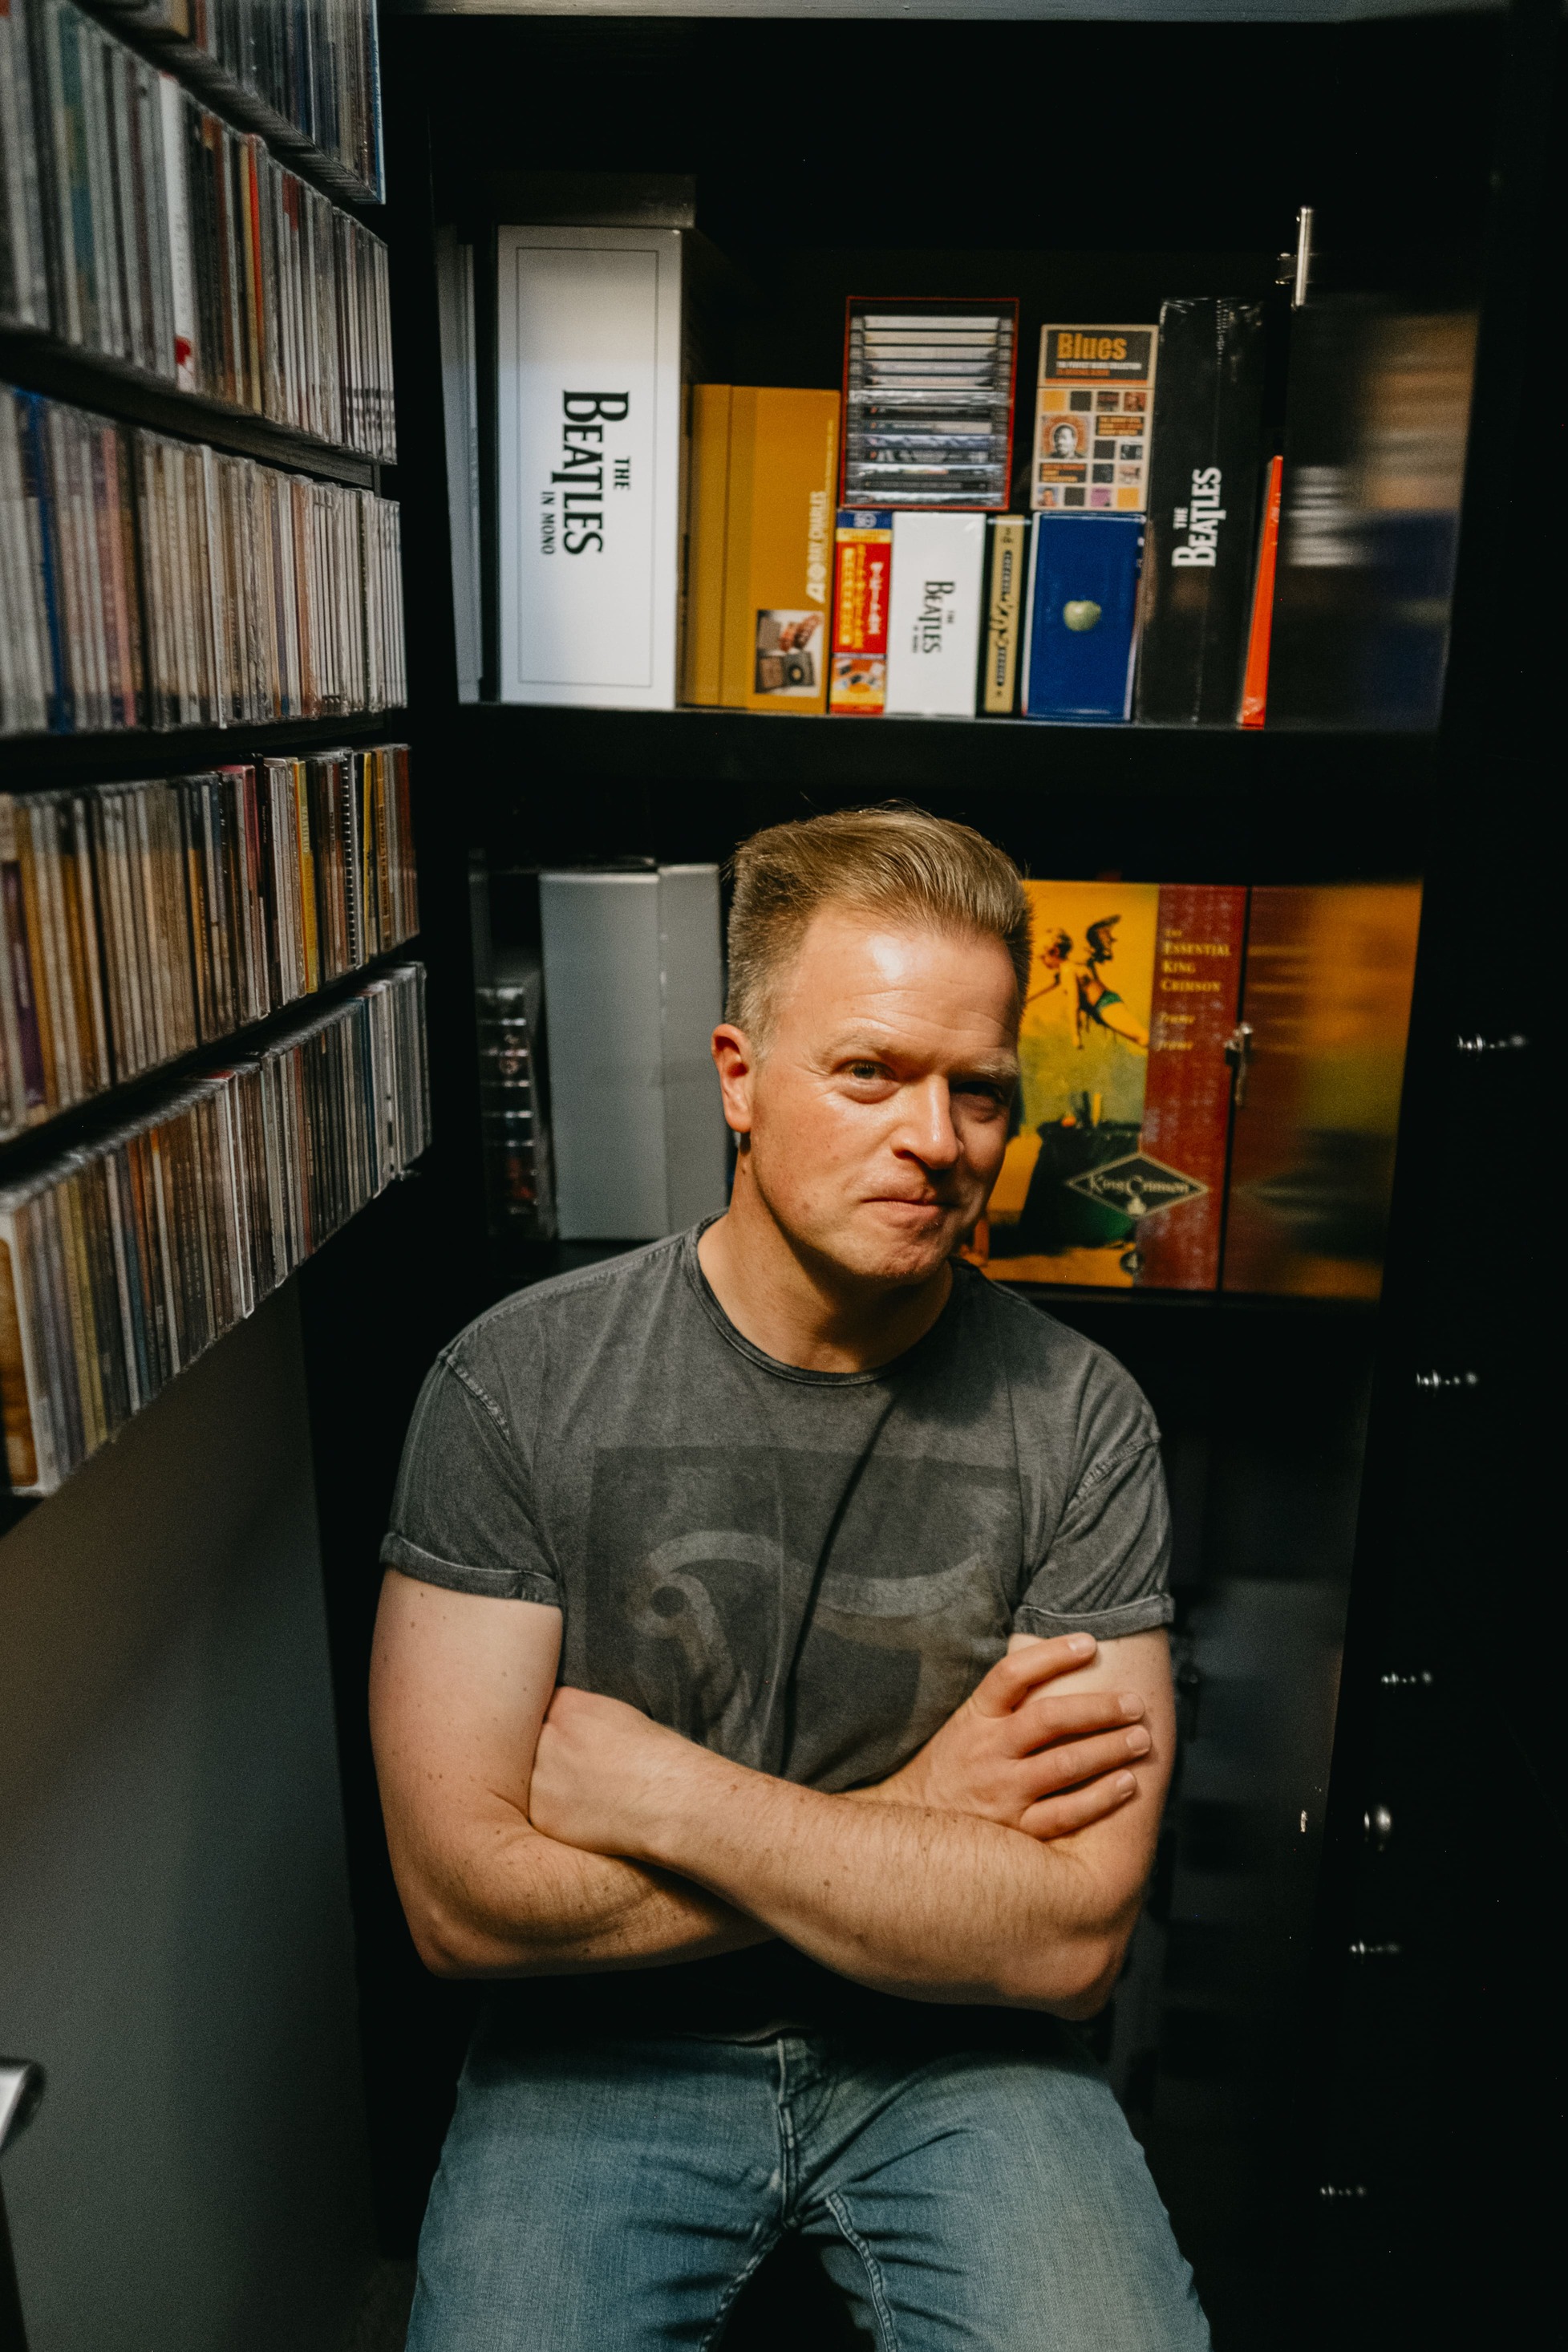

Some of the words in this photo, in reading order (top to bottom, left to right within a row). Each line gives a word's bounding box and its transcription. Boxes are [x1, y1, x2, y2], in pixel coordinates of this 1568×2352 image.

[1057, 332, 1128, 361] Blues
[551, 391, 630, 555] BEATLES
[614, 457, 630, 491] THE
[541, 491, 556, 505] IN
[1172, 466, 1226, 567] BEATLES
[1173, 506, 1189, 530] THE
[541, 513, 556, 556] MONO
[918, 580, 956, 654] BEATLES
[1163, 943, 1232, 957] ESSENTIAL
[1161, 959, 1197, 974] KING
[1160, 978, 1222, 992] CRIMSON
